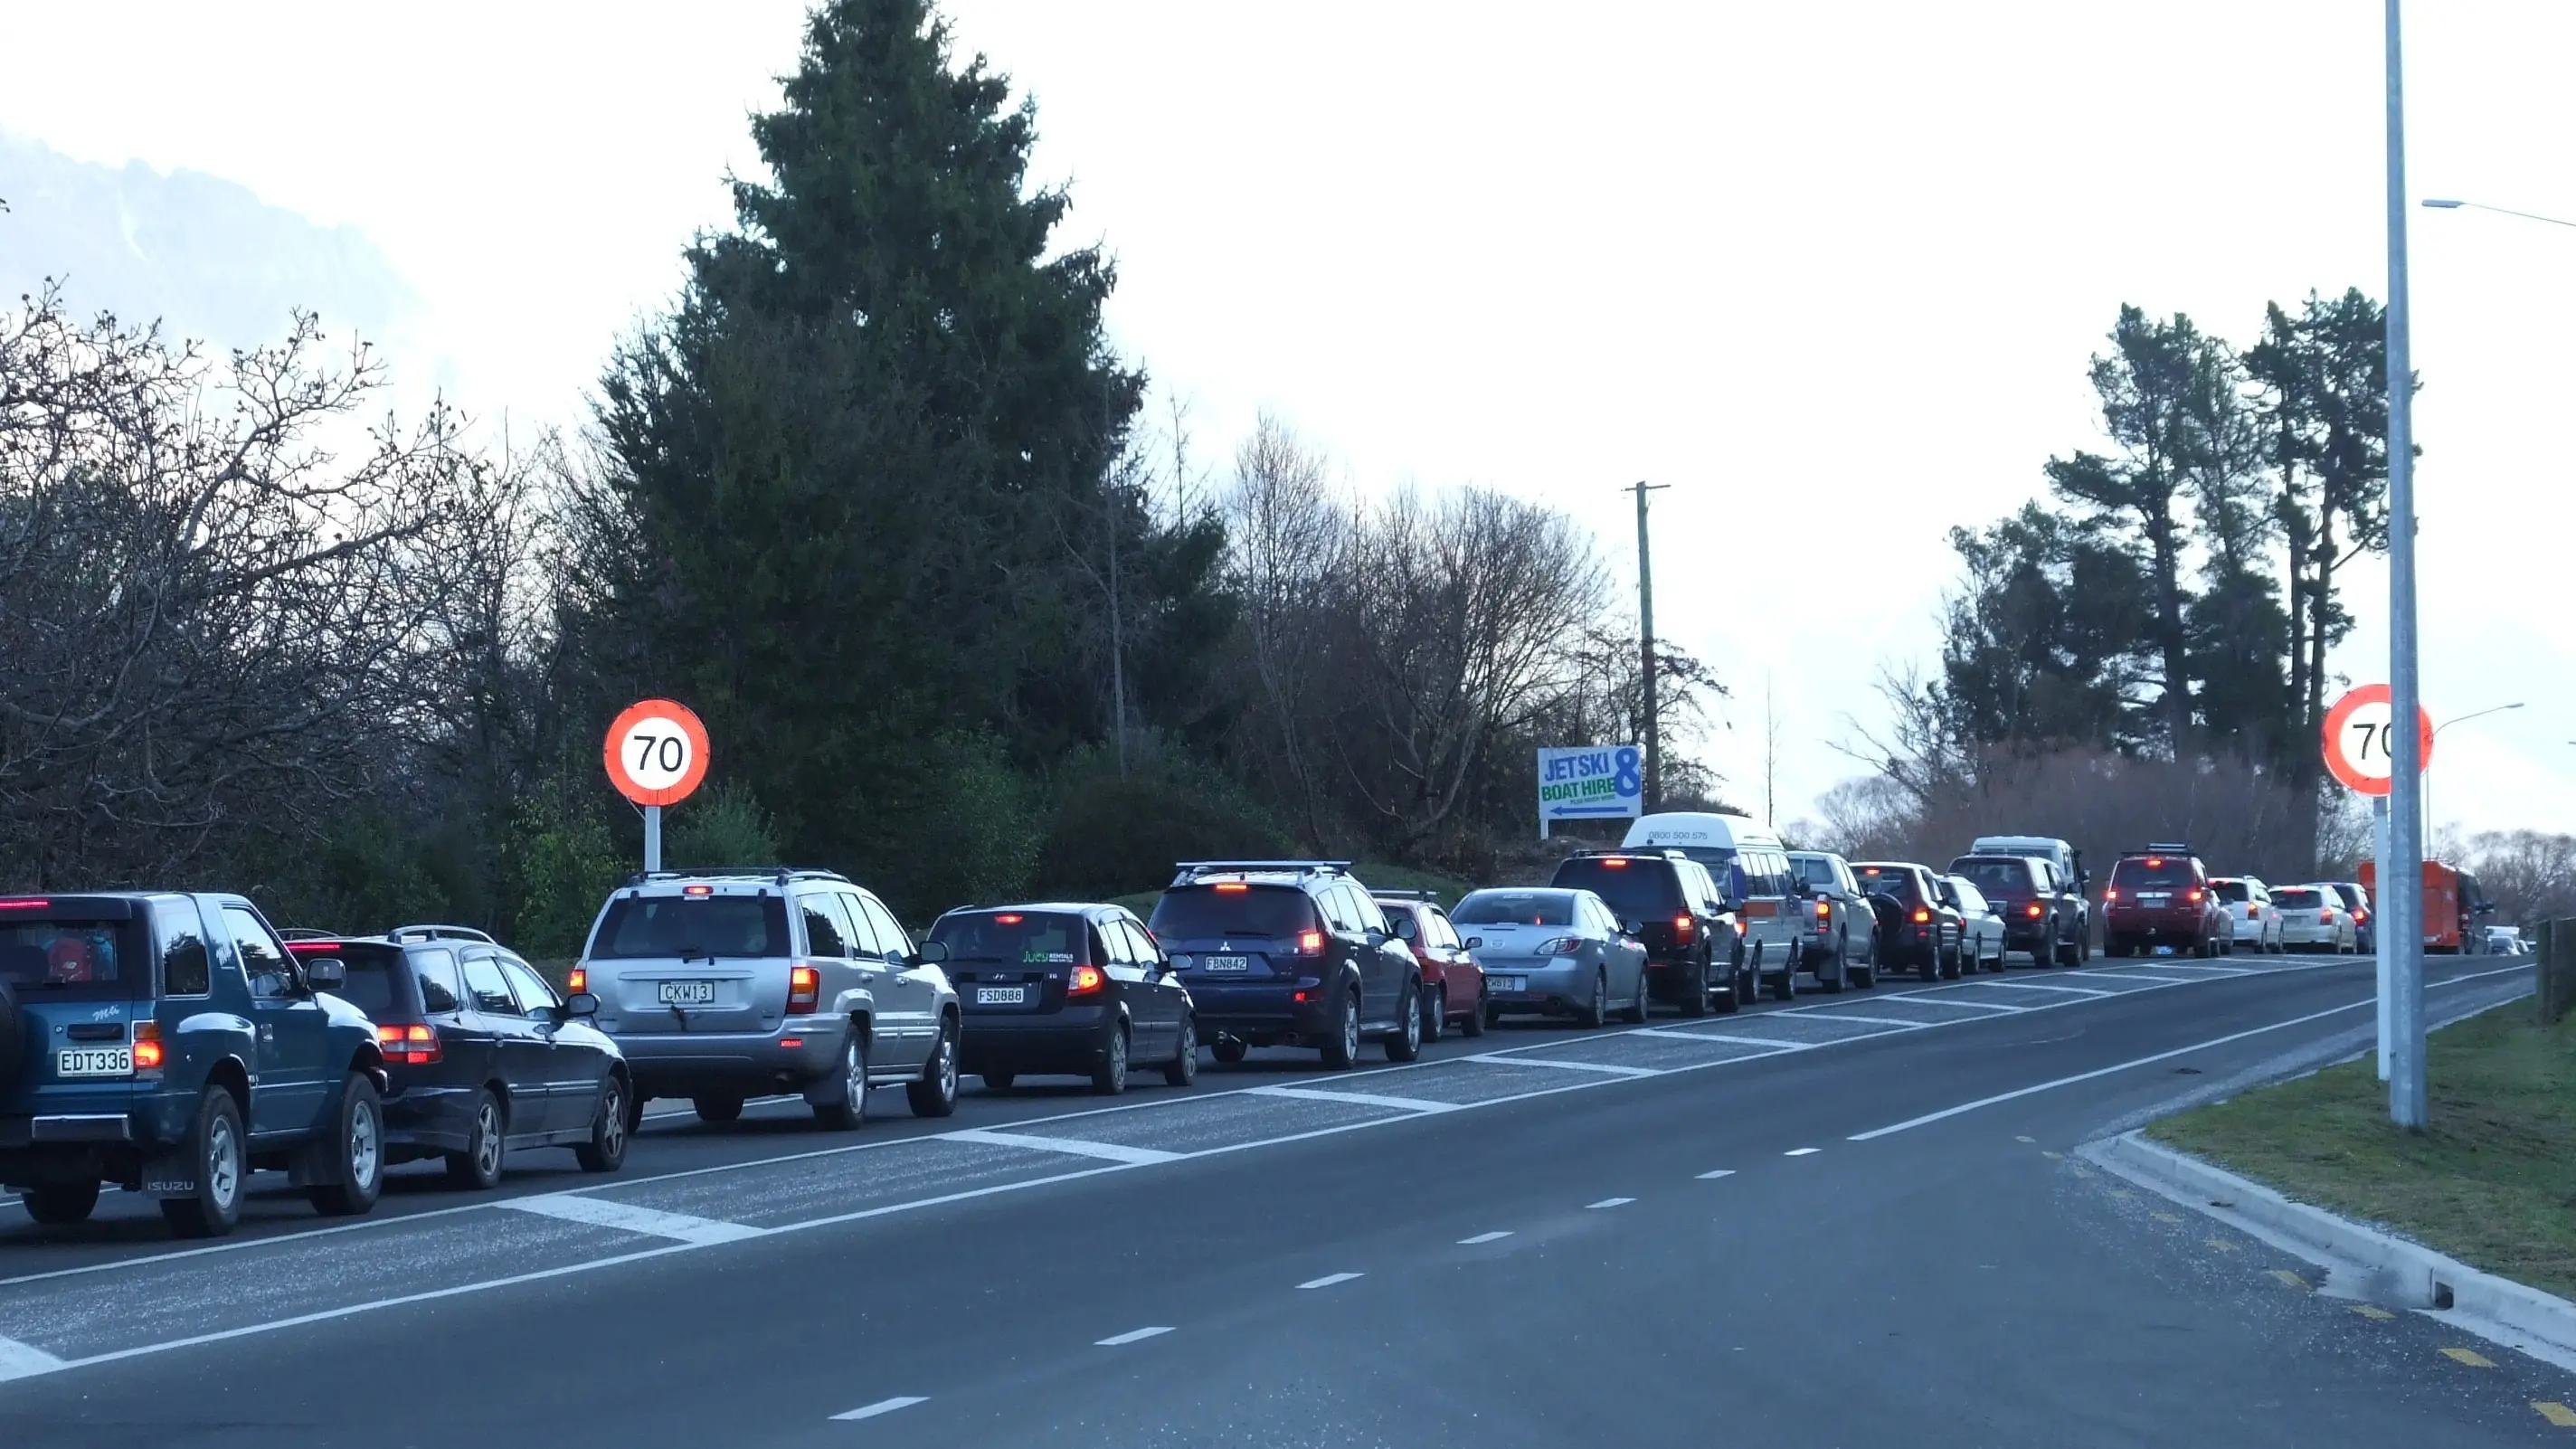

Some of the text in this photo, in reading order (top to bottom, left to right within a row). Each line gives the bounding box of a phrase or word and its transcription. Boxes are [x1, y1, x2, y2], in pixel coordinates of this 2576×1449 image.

[634, 735, 683, 772] 70
[1545, 753, 1609, 781] JET SKI
[1541, 777, 1615, 801] BOAT HIRE
[1648, 831, 1708, 840] 0800 500 575
[665, 985, 708, 1000] CKW13
[61, 1052, 129, 1072] EDT336
[147, 1181, 194, 1191] ISUZU
